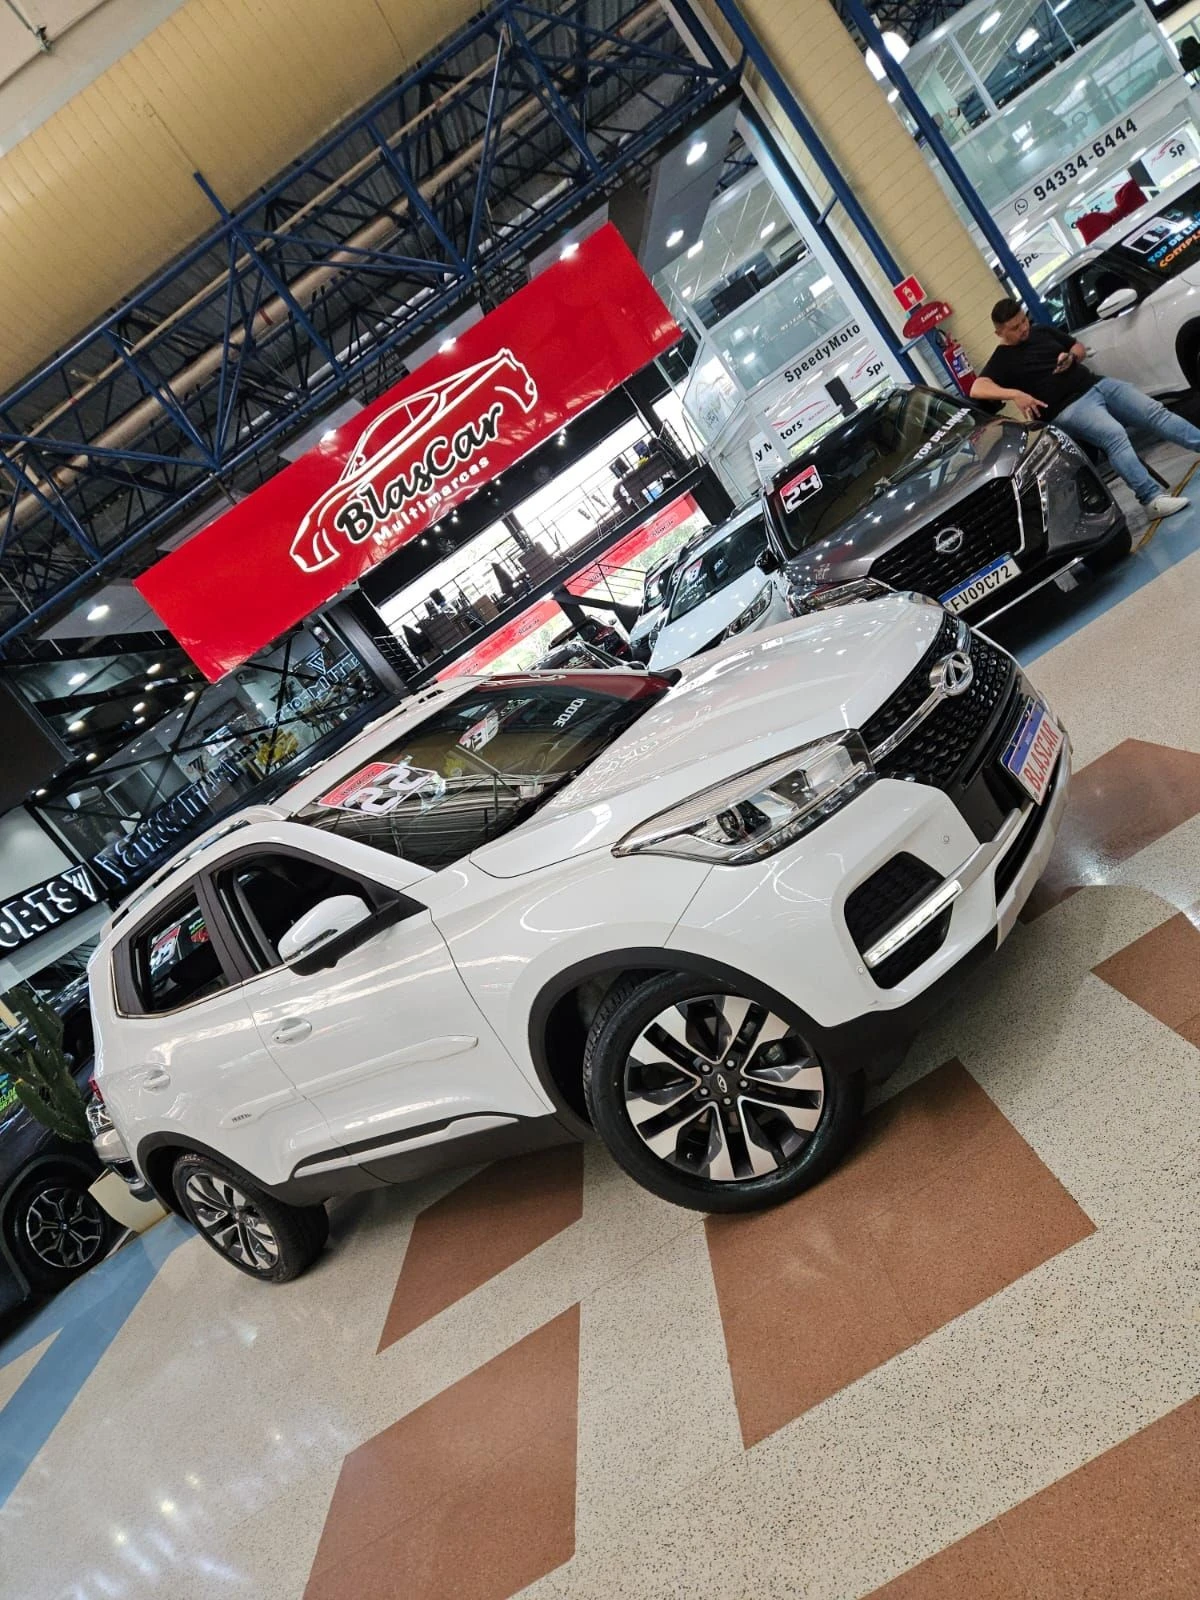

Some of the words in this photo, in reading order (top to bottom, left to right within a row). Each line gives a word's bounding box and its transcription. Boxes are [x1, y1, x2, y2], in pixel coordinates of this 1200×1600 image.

[1033, 118, 1137, 201] 94334-6444
[1148, 245, 1168, 264] TOP
[784, 323, 861, 383] SpeedyMoto
[779, 419, 803, 440] tors
[913, 442, 933, 460] TOP
[930, 429, 947, 443] DE
[941, 407, 972, 431] LINHA
[335, 403, 503, 543] BlasCar
[372, 456, 489, 546] Multimarcas
[783, 474, 820, 509] 24
[1023, 719, 1059, 793] BLASCAR
[343, 766, 430, 814] 22
